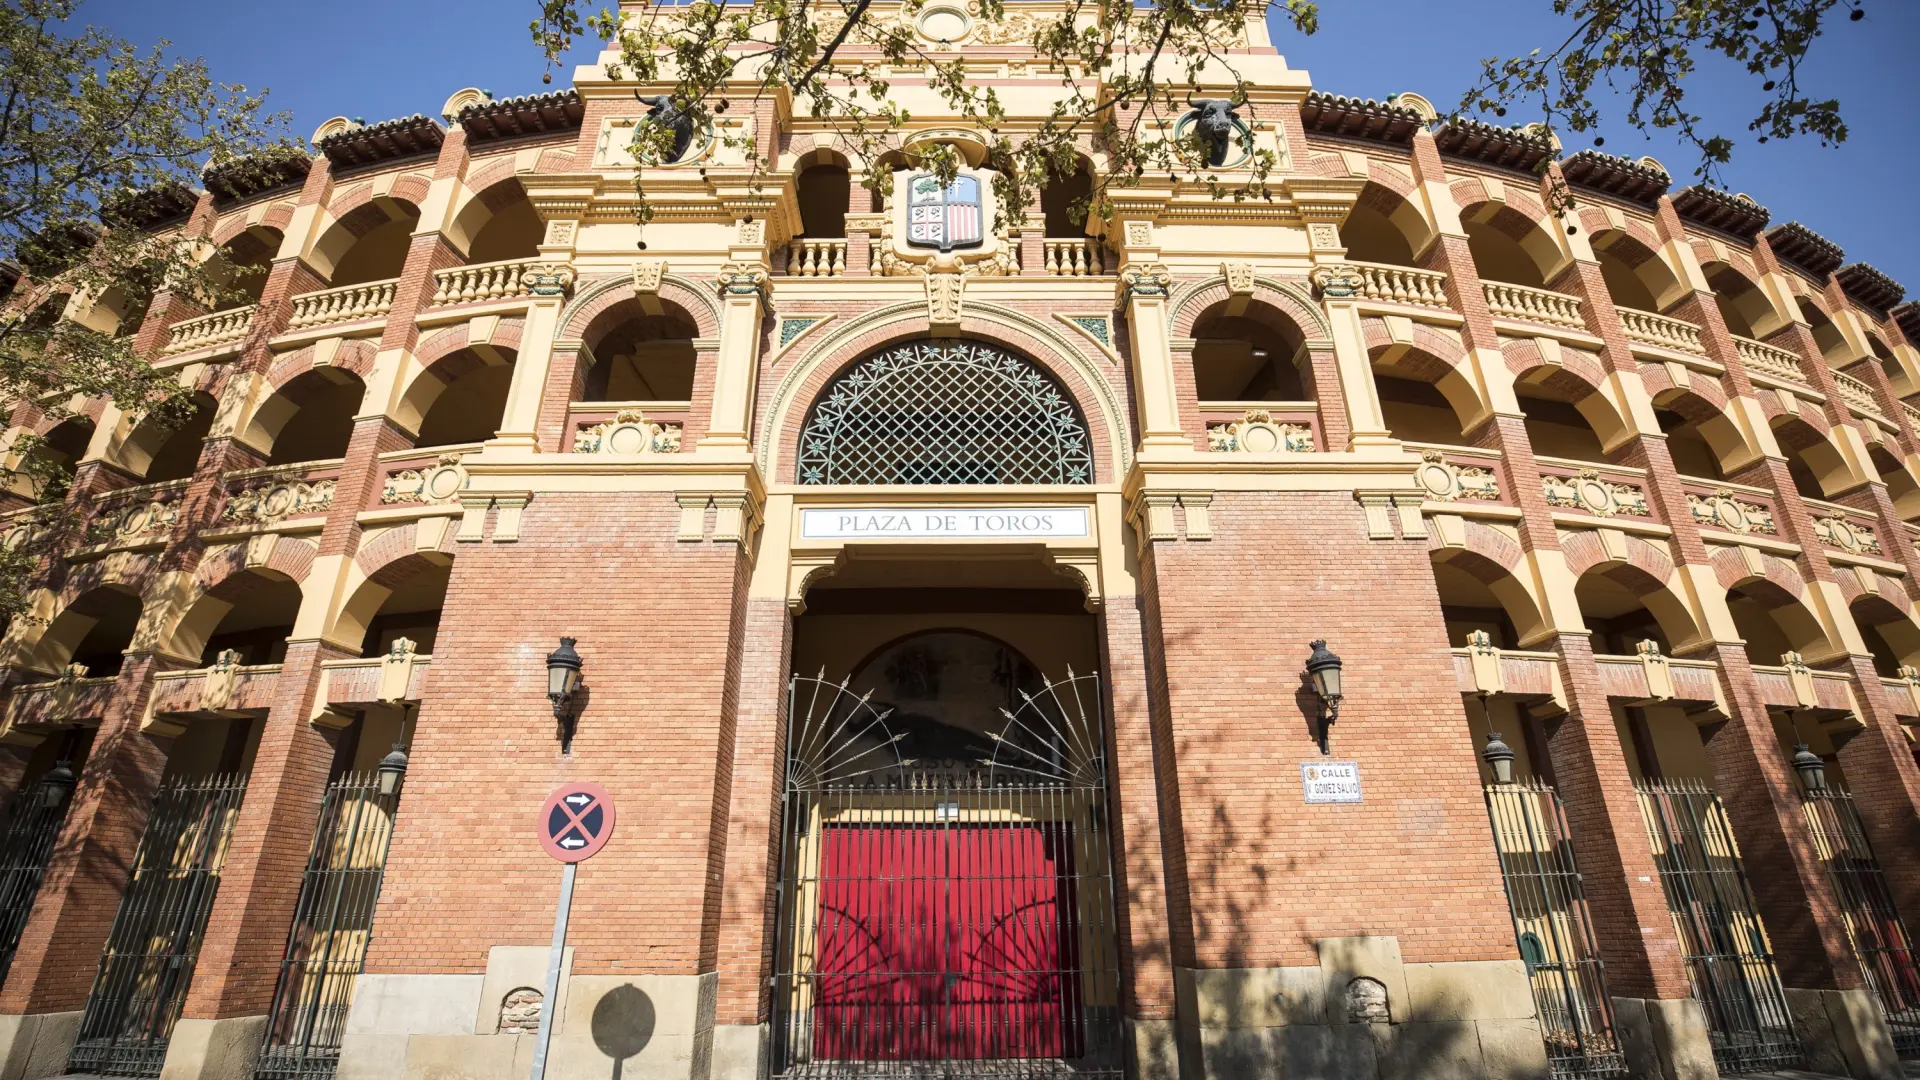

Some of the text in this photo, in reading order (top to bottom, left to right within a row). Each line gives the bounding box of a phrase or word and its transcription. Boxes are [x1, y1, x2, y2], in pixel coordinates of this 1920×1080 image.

[838, 515, 1053, 531] PLAZA DE TOROS
[1321, 769, 1351, 777] CALLE
[887, 774, 1045, 789] MISERCORDIA
[1337, 783, 1357, 794] SALVO
